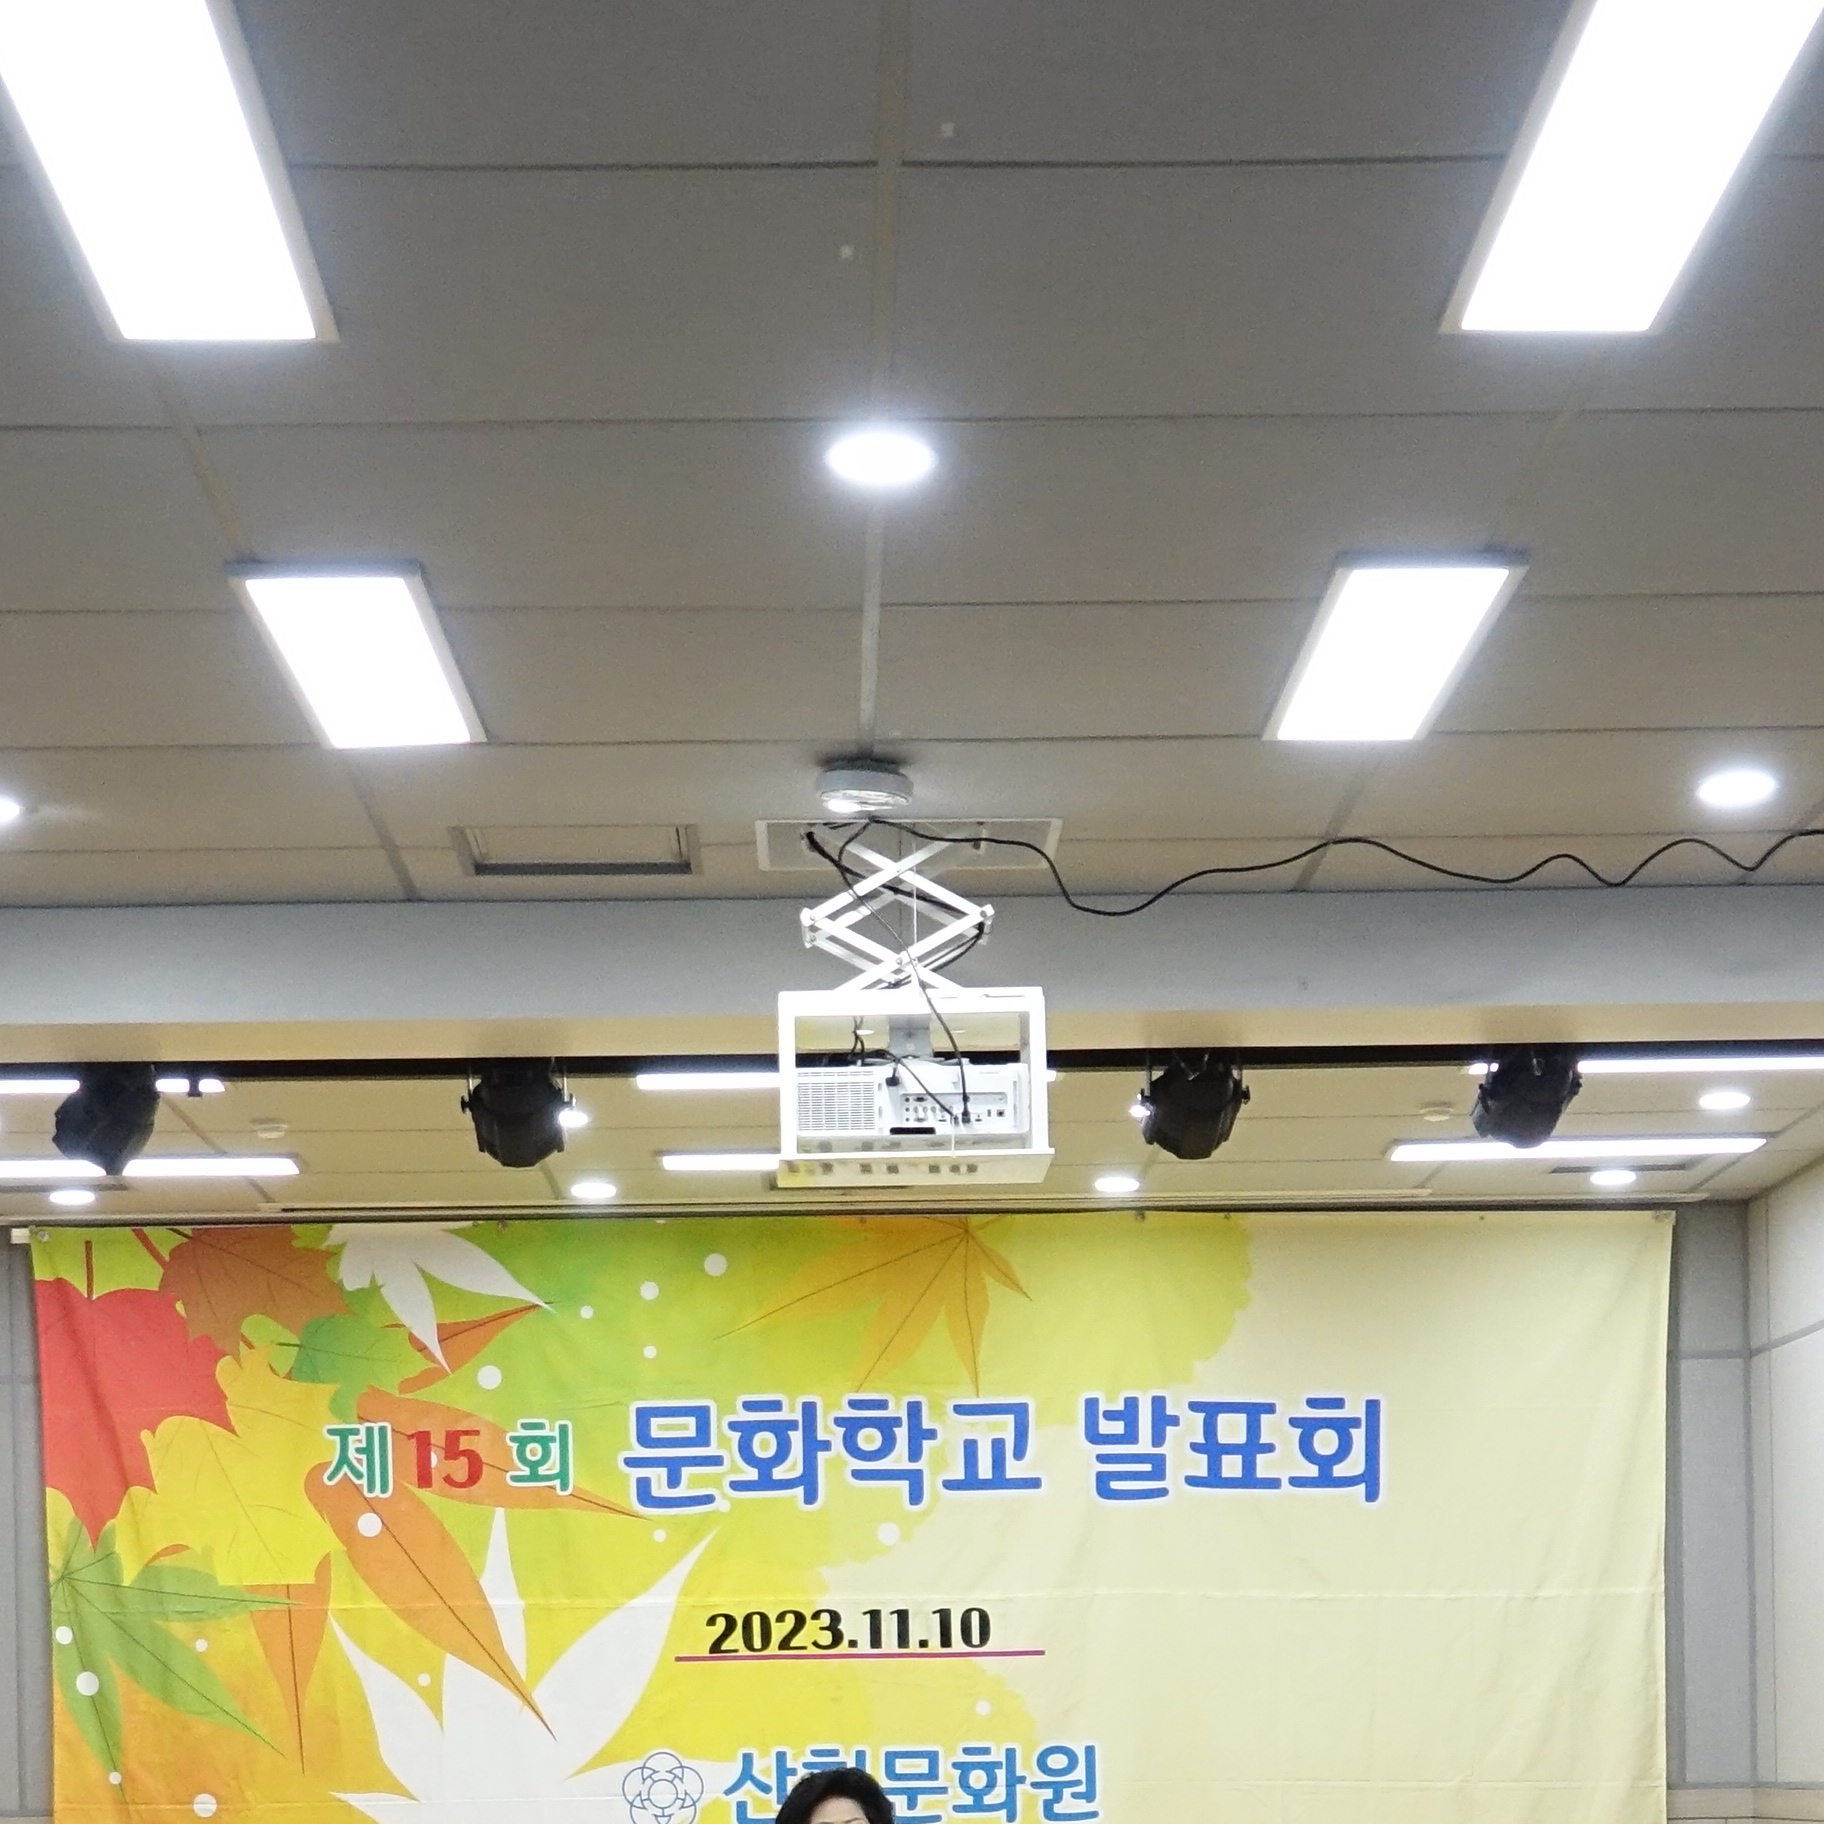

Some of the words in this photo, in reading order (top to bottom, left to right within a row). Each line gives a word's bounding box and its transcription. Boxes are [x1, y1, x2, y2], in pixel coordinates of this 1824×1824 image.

[623, 1399, 1041, 1510] 문화학교
[1083, 1396, 1381, 1504] 발표회
[705, 1606, 991, 1655] 2023.11.10
